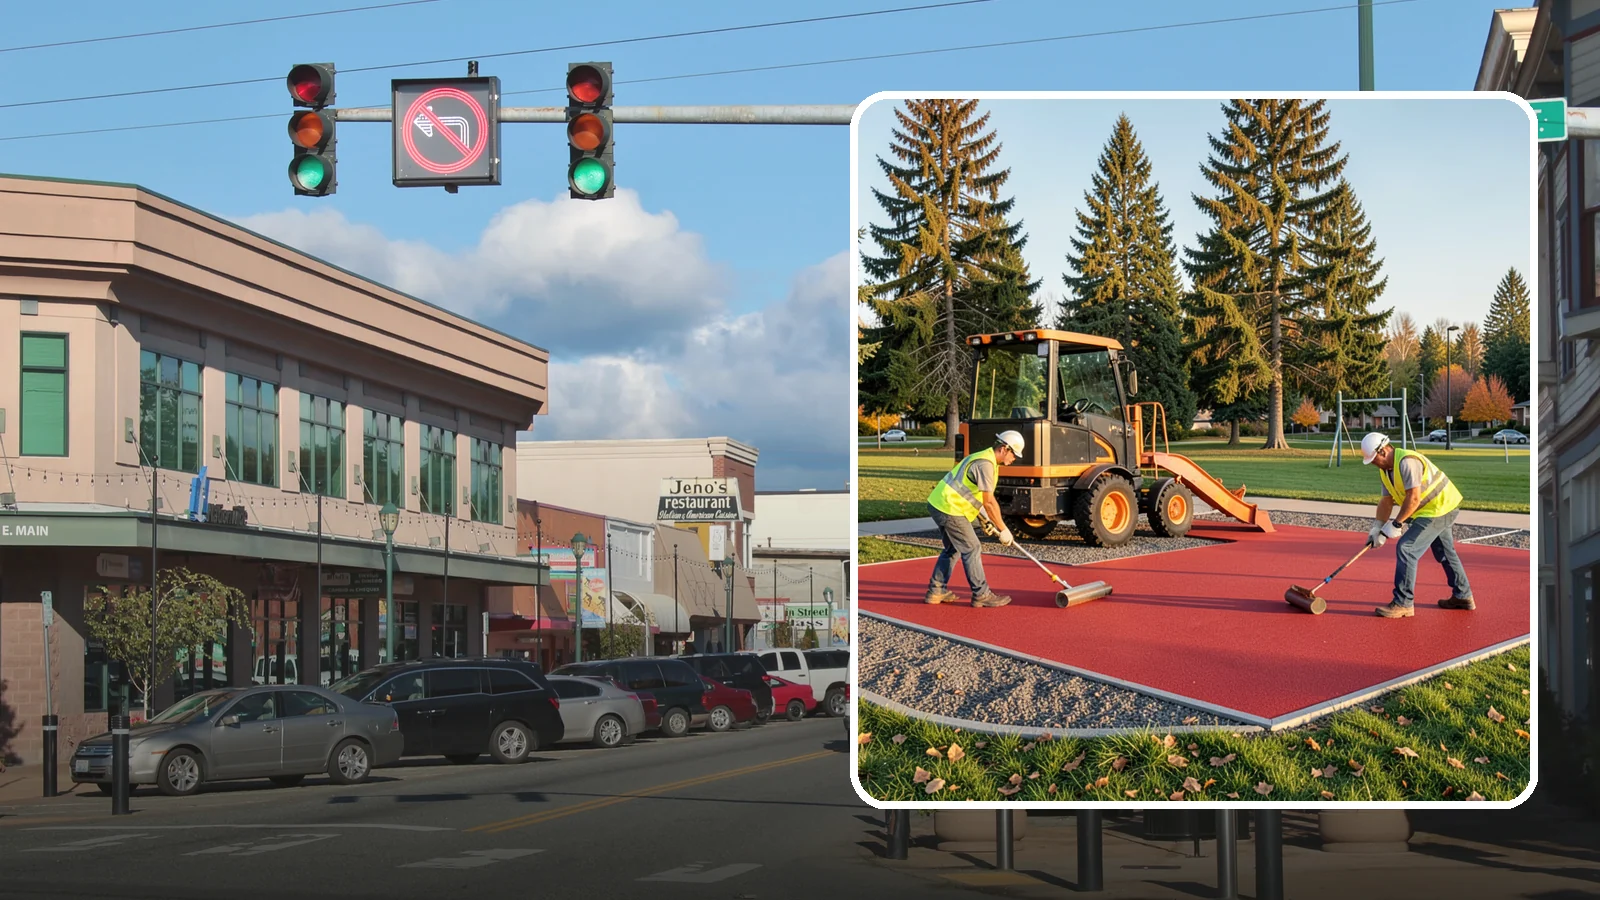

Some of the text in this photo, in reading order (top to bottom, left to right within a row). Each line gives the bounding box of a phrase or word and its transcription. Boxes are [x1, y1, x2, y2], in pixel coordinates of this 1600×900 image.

[670, 480, 727, 494] Jeno's
[665, 496, 731, 509] restaurant
[686, 509, 714, 519] American
[715, 510, 737, 519] Cuisine
[2, 525, 49, 536] E. MAIN
[798, 608, 828, 616] Street
[791, 619, 824, 627] lass
